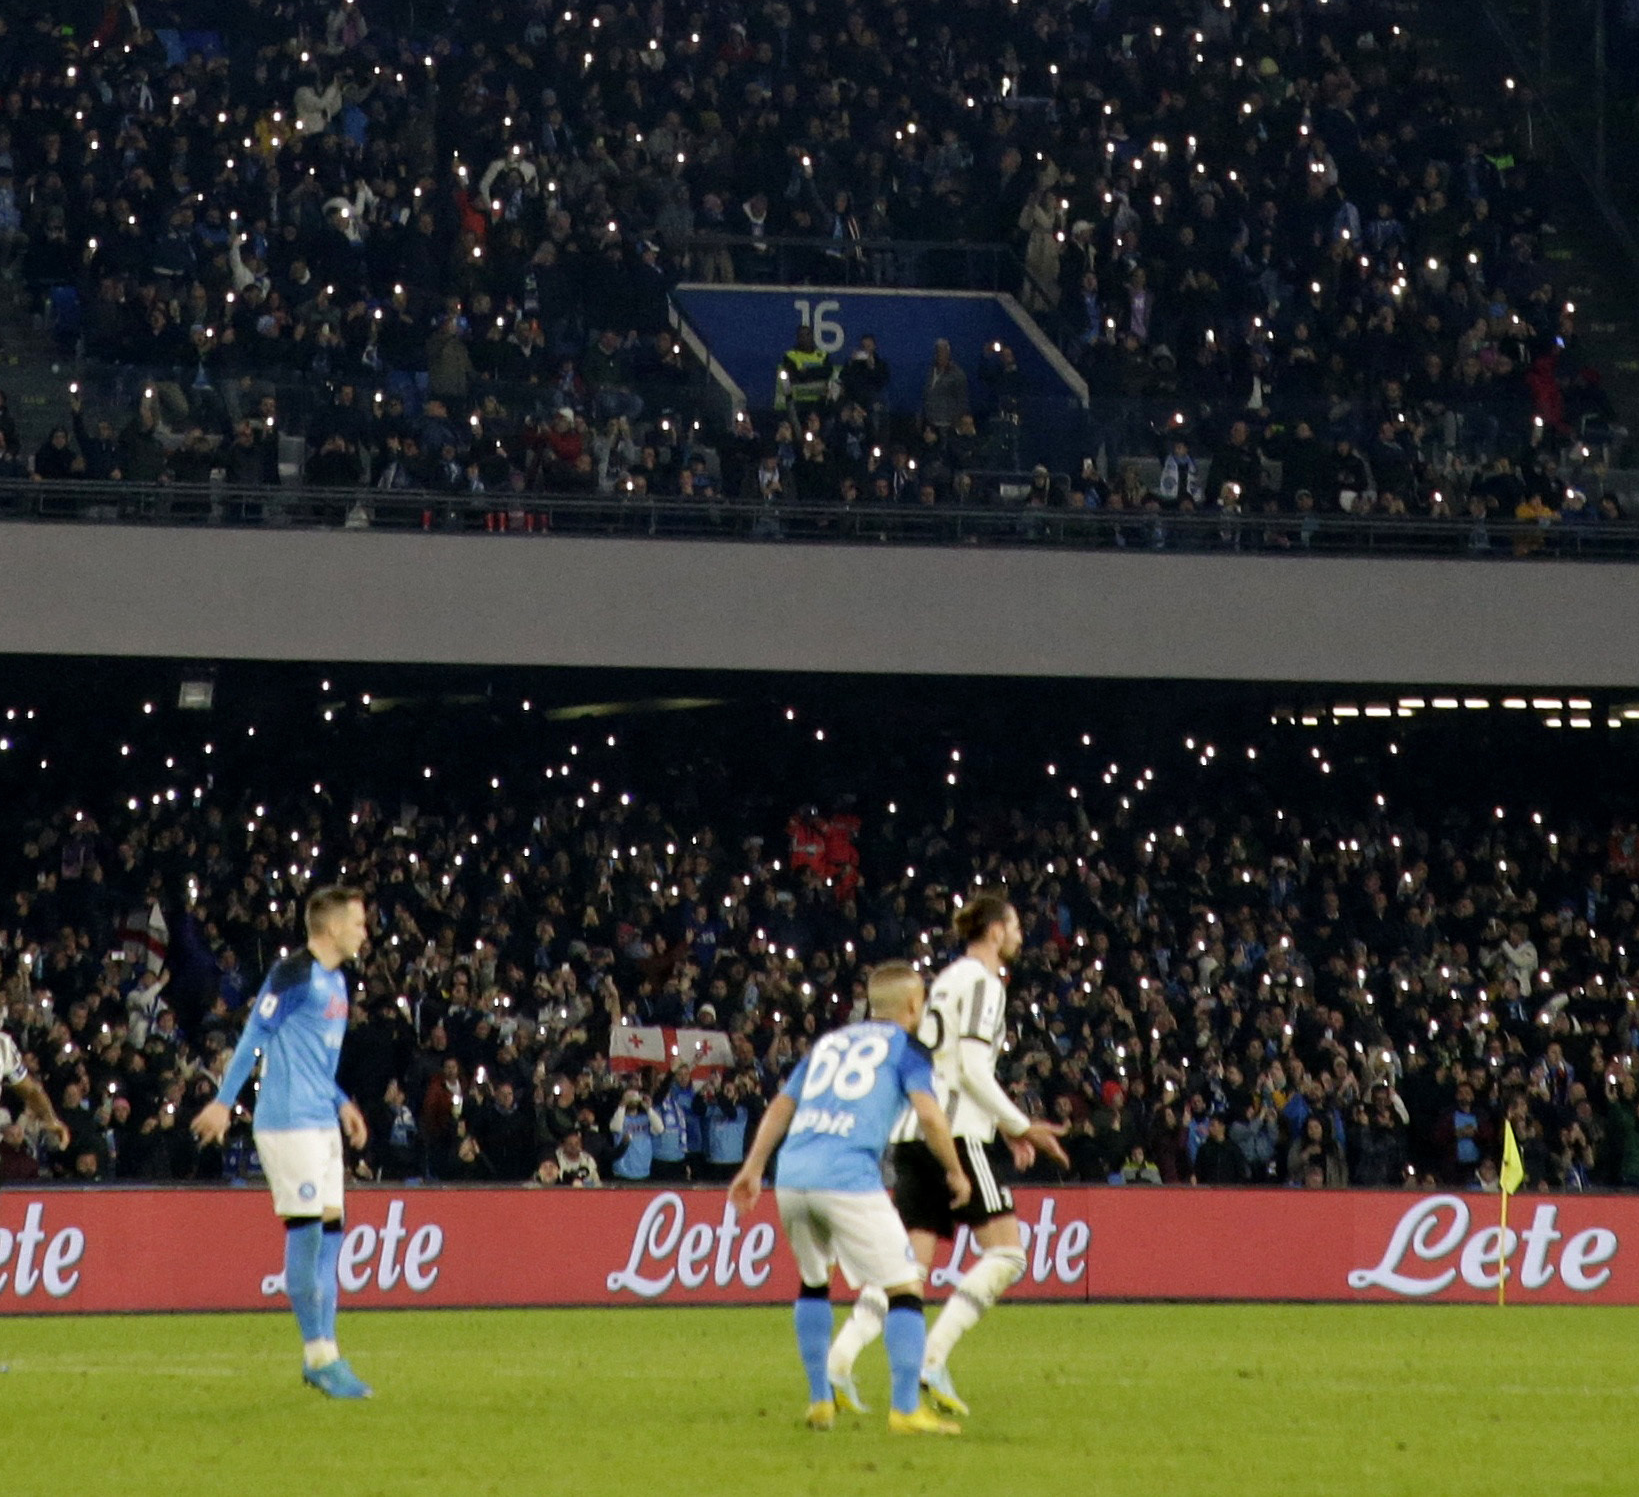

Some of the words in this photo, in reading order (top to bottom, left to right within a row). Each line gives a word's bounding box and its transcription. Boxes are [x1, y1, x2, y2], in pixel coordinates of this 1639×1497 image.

[793, 299, 846, 353] 16
[801, 1034, 890, 1100] 68
[606, 1191, 776, 1299] Lete
[1347, 1193, 1619, 1296] Lete
